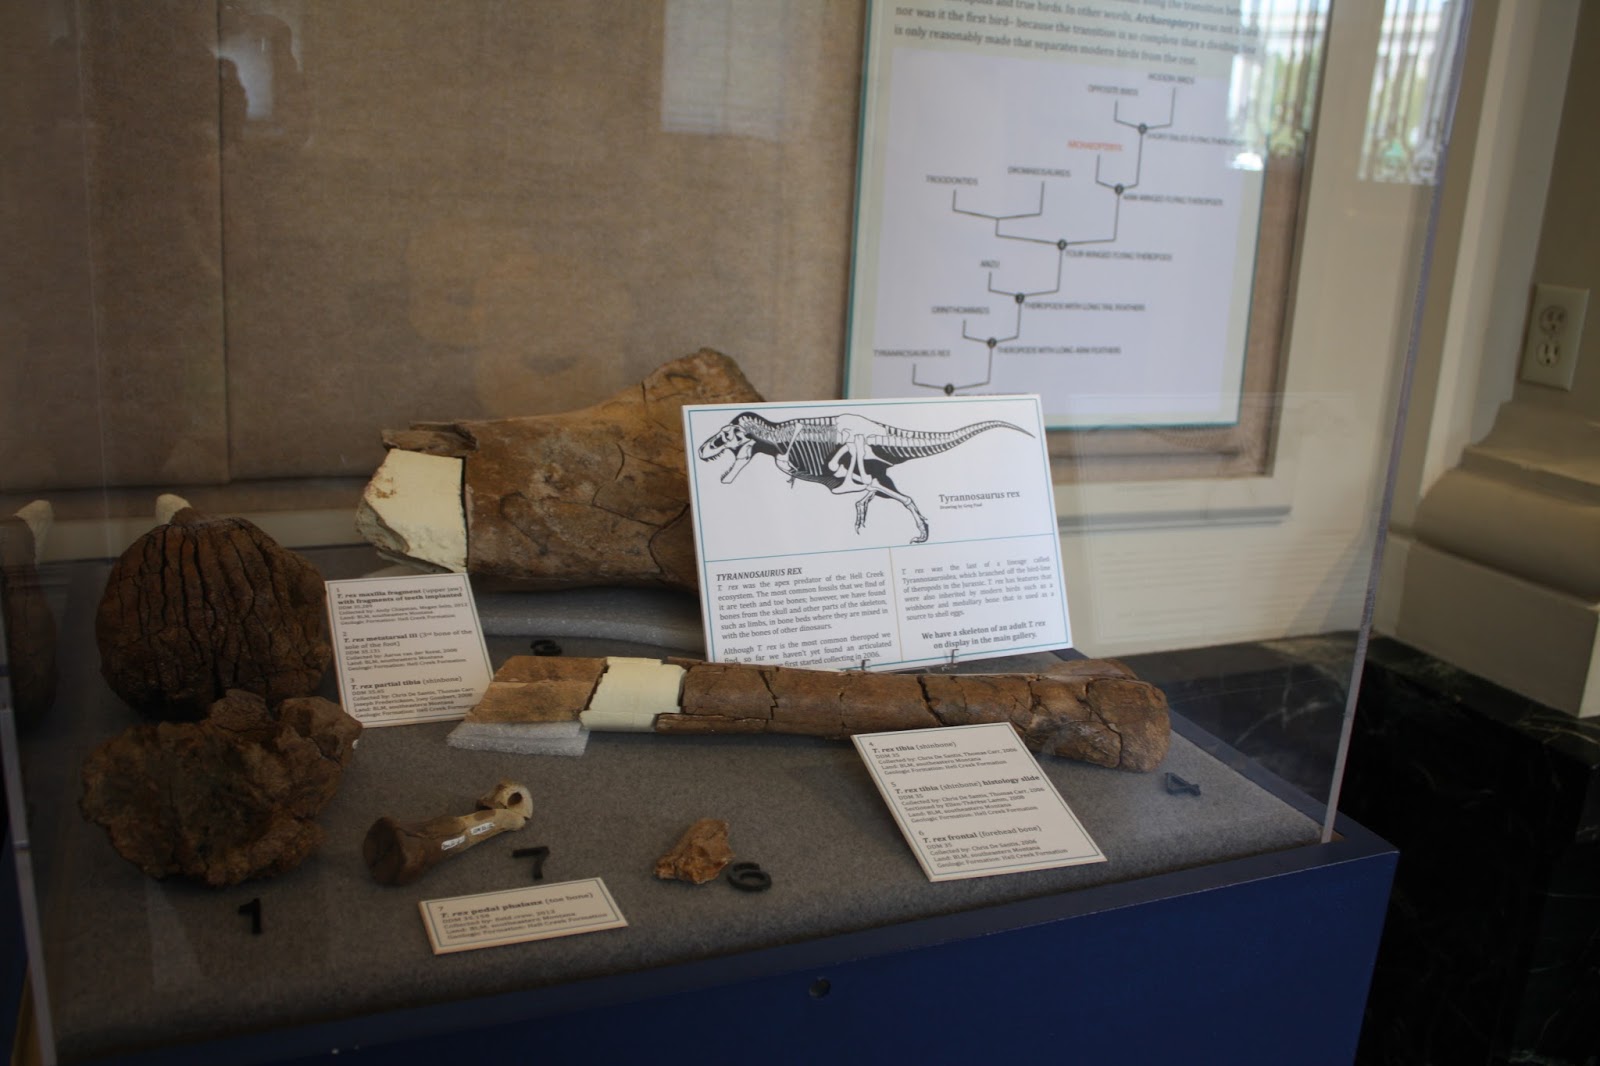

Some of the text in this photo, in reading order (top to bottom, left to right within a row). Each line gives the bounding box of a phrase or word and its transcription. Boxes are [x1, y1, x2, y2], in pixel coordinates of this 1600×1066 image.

[939, 492, 1005, 504] Tyrannosaurus
[717, 568, 803, 581] TYRANNOSAURUS REX
[759, 580, 771, 588] the
[774, 580, 790, 588] apex
[793, 576, 822, 587] predator
[835, 574, 847, 582] the
[849, 572, 864, 580] Hell
[865, 570, 885, 579] Creek
[718, 591, 754, 602] ecosystem.
[756, 589, 769, 597] The
[770, 588, 787, 596] most
[788, 587, 817, 595] common
[817, 583, 839, 592] fossils
[839, 582, 853, 590] that
[864, 580, 878, 588] find
[878, 579, 886, 587] of
[739, 600, 758, 608] teeth
[758, 598, 773, 607] and
[850, 591, 867, 599] have
[867, 588, 887, 597] found
[720, 612, 741, 620] bones
[759, 609, 771, 617] the
[771, 607, 788, 615] skull
[789, 606, 802, 614] and
[802, 605, 821, 613] other
[821, 603, 839, 613] parts
[839, 602, 847, 610] of
[847, 601, 859, 609] the
[721, 621, 737, 629] such
[795, 614, 811, 623] beds
[812, 613, 833, 621] where
[833, 611, 848, 621] they
[861, 608, 881, 617] mixed
[722, 630, 738, 639] with
[738, 630, 750, 638] the
[772, 627, 780, 635] of
[780, 626, 798, 634] other
[922, 631, 933, 639] We
[934, 630, 952, 638] have
[958, 625, 990, 635] skeleton
[990, 624, 998, 632] of
[1009, 621, 1027, 630] adult
[723, 645, 755, 655] Although
[787, 640, 799, 648] the
[801, 638, 818, 647] most
[819, 637, 848, 645] common
[849, 632, 880, 643] theropod
[782, 649, 807, 659] haven't
[810, 647, 821, 658] yet
[823, 645, 844, 654] found
[858, 640, 893, 651] articulated
[944, 638, 970, 649] display
[971, 637, 980, 645] in
[979, 636, 992, 644] the
[993, 634, 1011, 643] main
[1012, 632, 1038, 643] gallery.
[785, 658, 799, 667] first
[799, 656, 823, 666] started
[823, 654, 855, 663] collecting
[863, 651, 881, 660] 2006.
[374, 680, 402, 690] partial
[422, 676, 463, 686] (shinbone)
[895, 744, 915, 752] tibia
[915, 741, 958, 752] (shinbone)
[918, 784, 939, 792] tibia
[939, 780, 982, 792] (shinbone)
[982, 778, 1020, 786] histology
[1020, 775, 1041, 783] slide
[1164, 772, 1201, 796] 4
[947, 831, 978, 841] frontal
[978, 827, 1017, 839] (forehead
[1018, 825, 1043, 834] bone)
[513, 846, 550, 880] 7
[727, 862, 772, 892] 6
